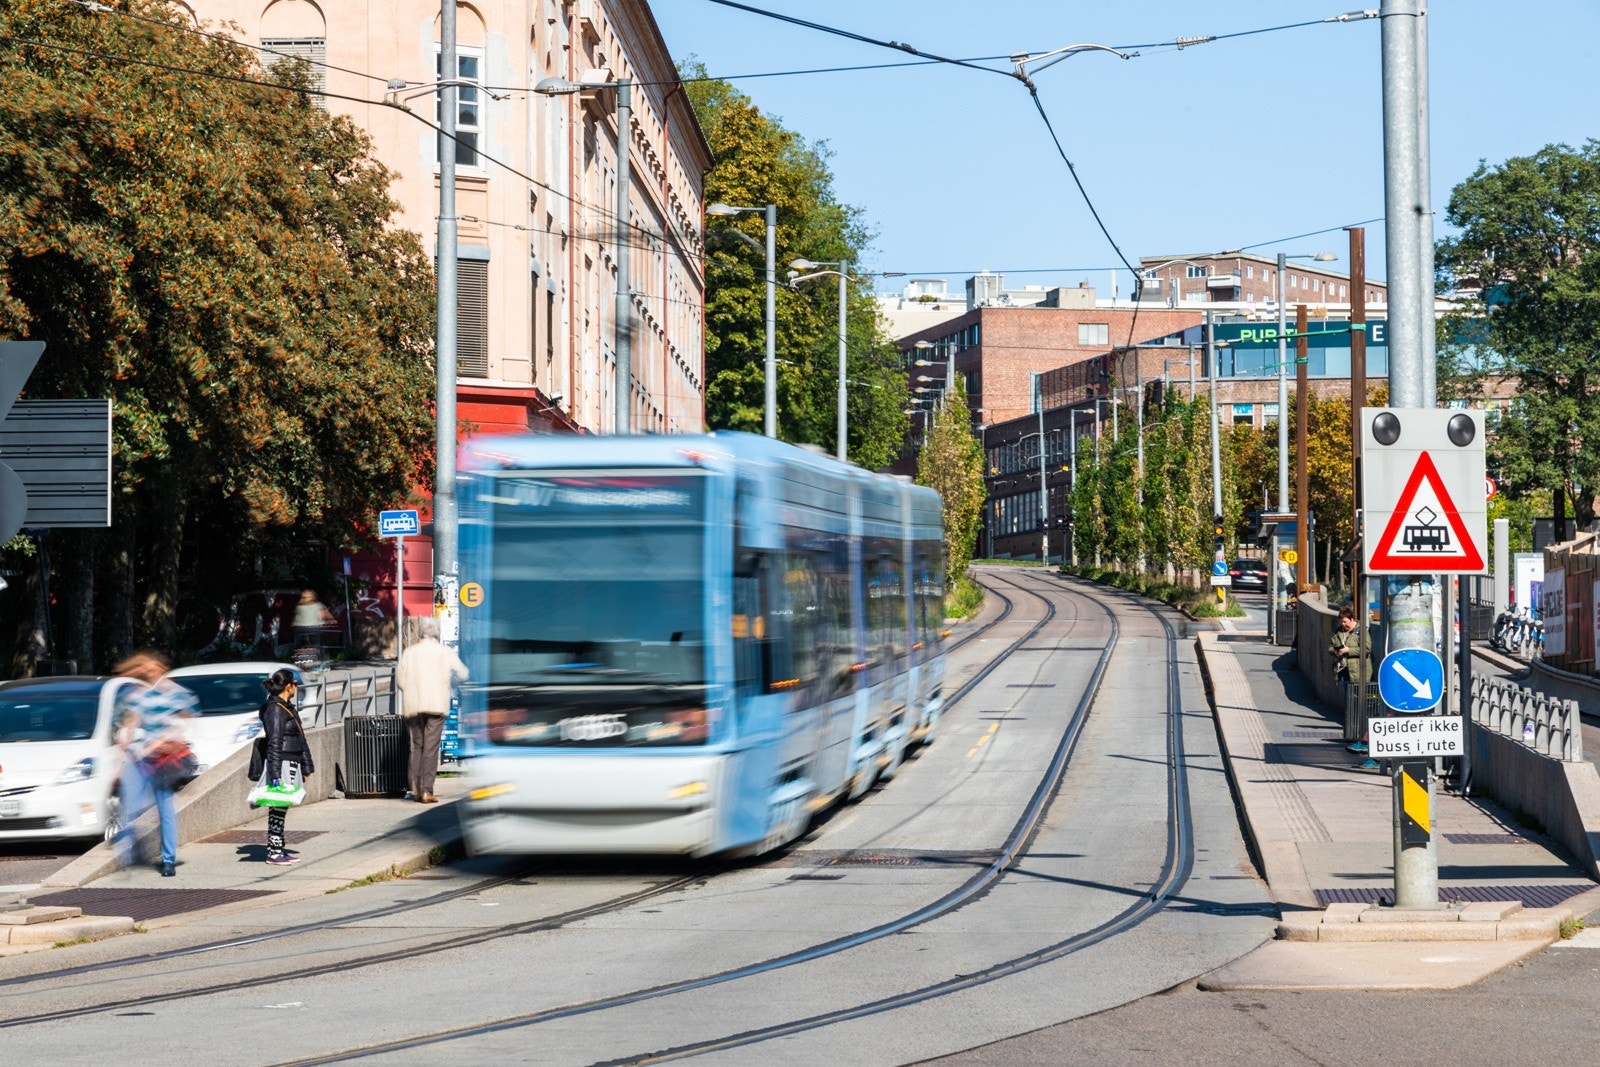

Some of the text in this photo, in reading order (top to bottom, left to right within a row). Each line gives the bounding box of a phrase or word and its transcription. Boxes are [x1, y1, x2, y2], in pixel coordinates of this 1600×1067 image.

[467, 587, 478, 603] E
[1372, 719, 1459, 736] Gjelder ikke
[1376, 739, 1456, 752] buss i rute
